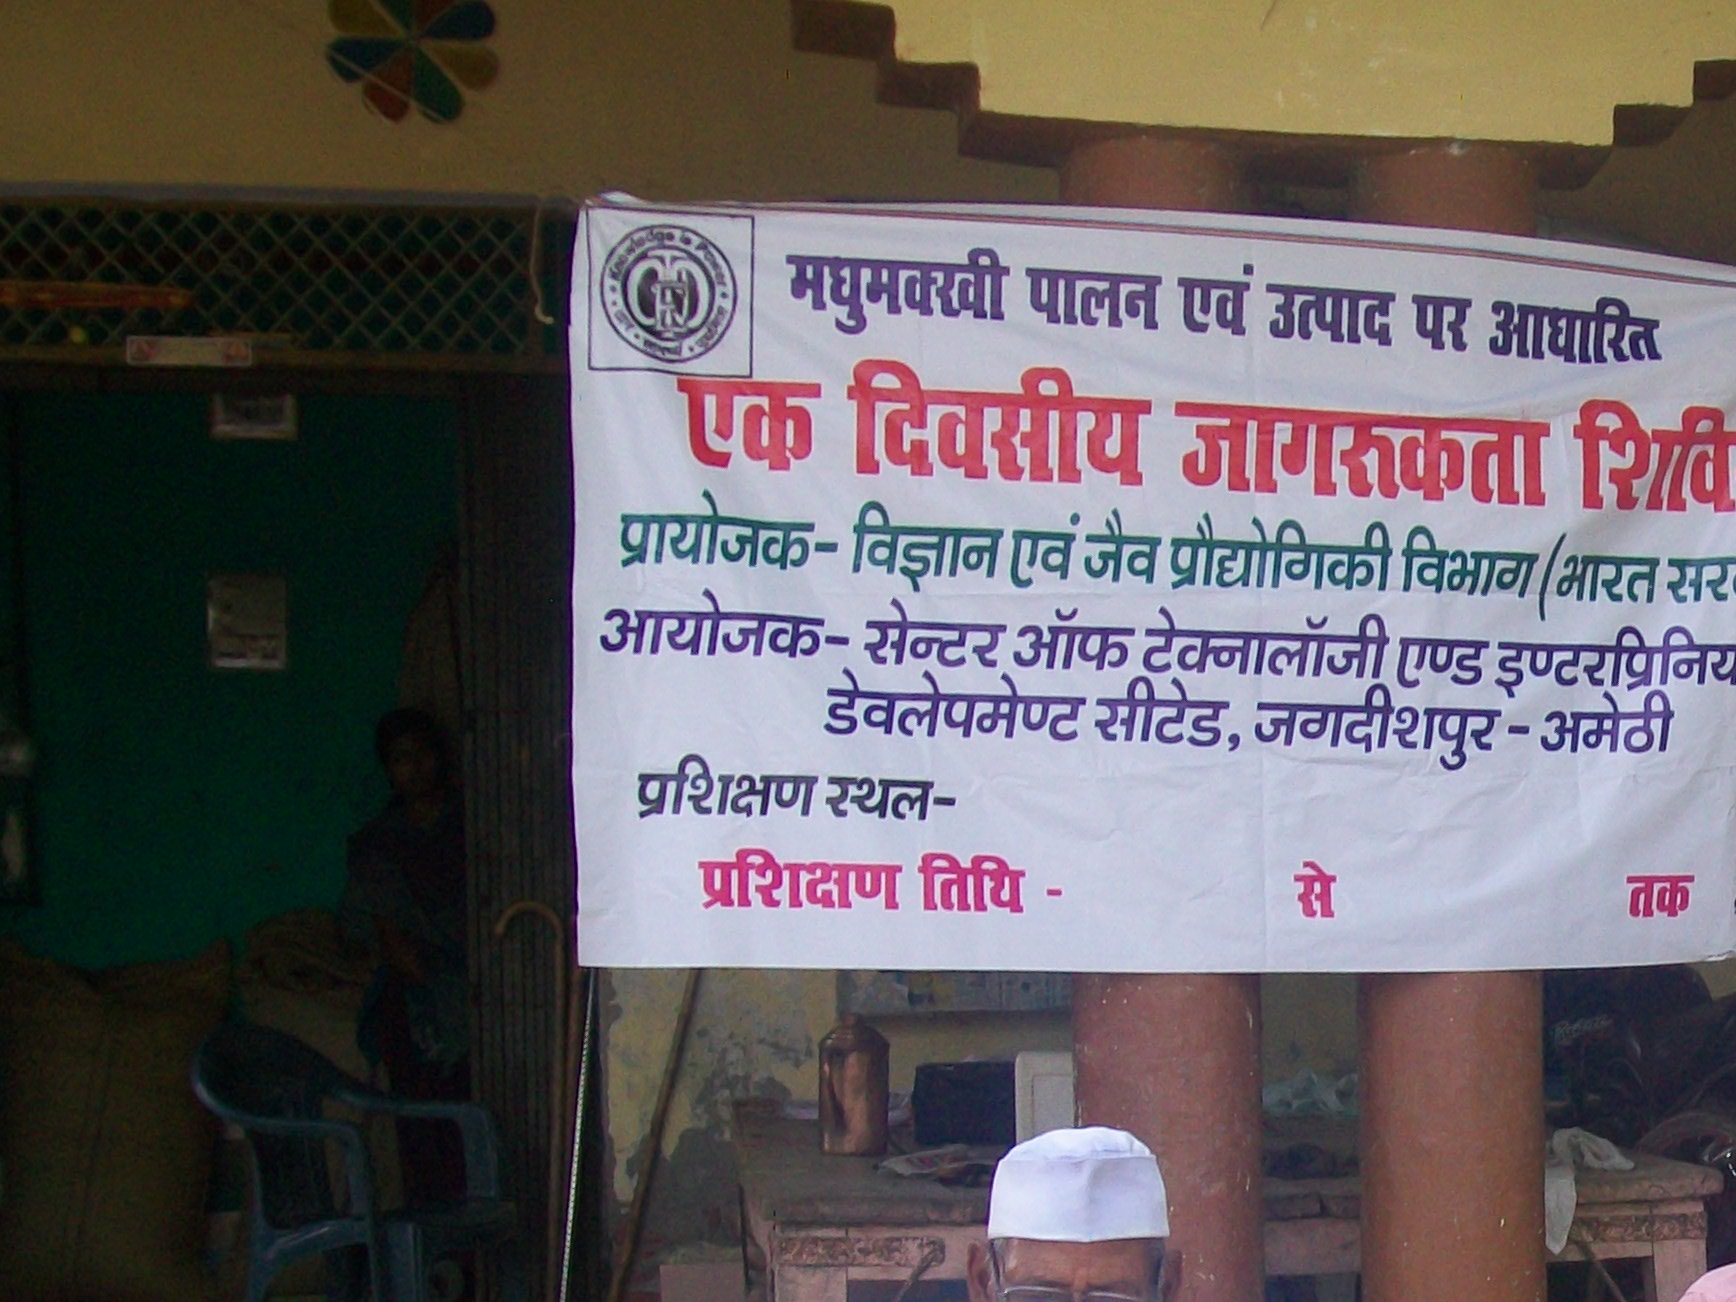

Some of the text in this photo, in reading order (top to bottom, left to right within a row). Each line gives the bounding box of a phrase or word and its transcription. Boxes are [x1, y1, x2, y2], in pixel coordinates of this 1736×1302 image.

[1027, 268, 1162, 330] पालन
[1178, 264, 1253, 337] एवं
[1266, 283, 1395, 346] उत्पाद
[1412, 294, 1470, 351] पर
[1489, 297, 1662, 363] आधारित
[677, 378, 821, 471] एक
[847, 359, 1152, 486] दिवसीय
[852, 500, 1003, 591] विज्ञान
[1010, 514, 1080, 587] एवं
[1084, 508, 1161, 586] जैव
[1171, 508, 1392, 592] प्रौद्योगिकी
[1401, 525, 1538, 599] विभाग
[864, 598, 1007, 668] सेन्टर
[1013, 608, 1135, 670] ऑफ
[1142, 607, 1389, 680] टेक्नालॉजी
[1398, 636, 1489, 687] एण्ड
[824, 668, 1086, 741] डेवलेपमेण्ट
[1540, 690, 1674, 754] अमेठी
[637, 754, 818, 819] प्रशिक्षण
[699, 848, 902, 911] प्रशिक्षण
[1294, 860, 1337, 919] से
[1627, 873, 1696, 919] तक
